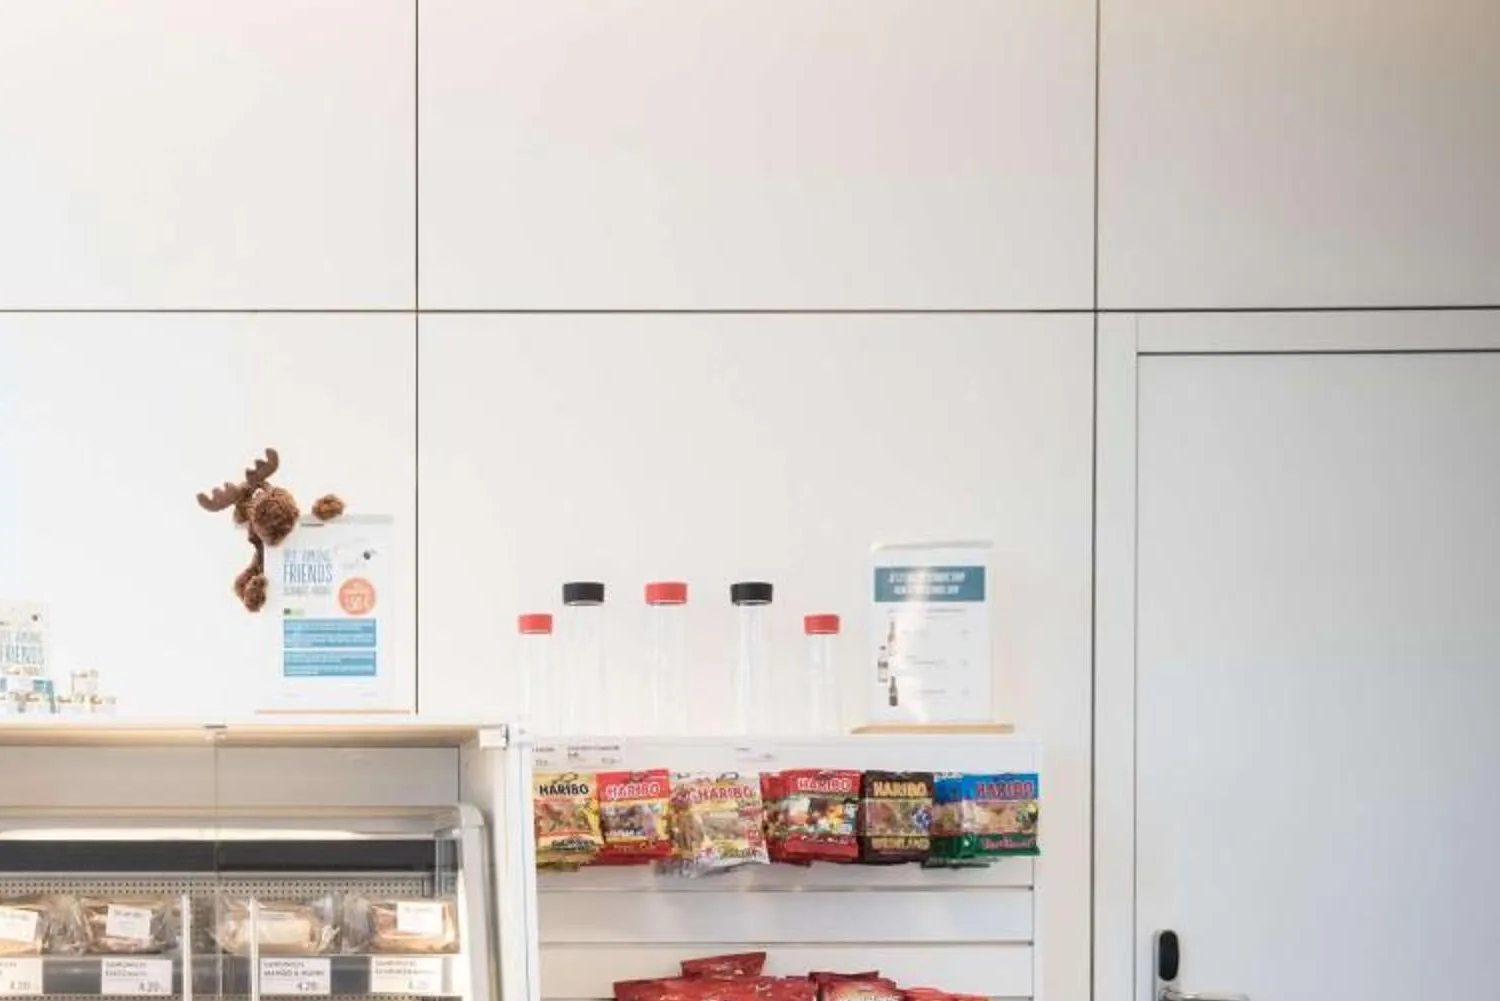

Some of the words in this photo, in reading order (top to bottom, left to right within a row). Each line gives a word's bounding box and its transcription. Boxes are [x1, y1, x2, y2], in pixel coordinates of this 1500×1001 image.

[283, 563, 333, 585] FRIENDS
[539, 783, 590, 797] HARIBO
[605, 782, 661, 799] HARIBO
[699, 784, 755, 800] HARIBO
[797, 777, 853, 793] HARIBO
[874, 781, 928, 797] HARIBO
